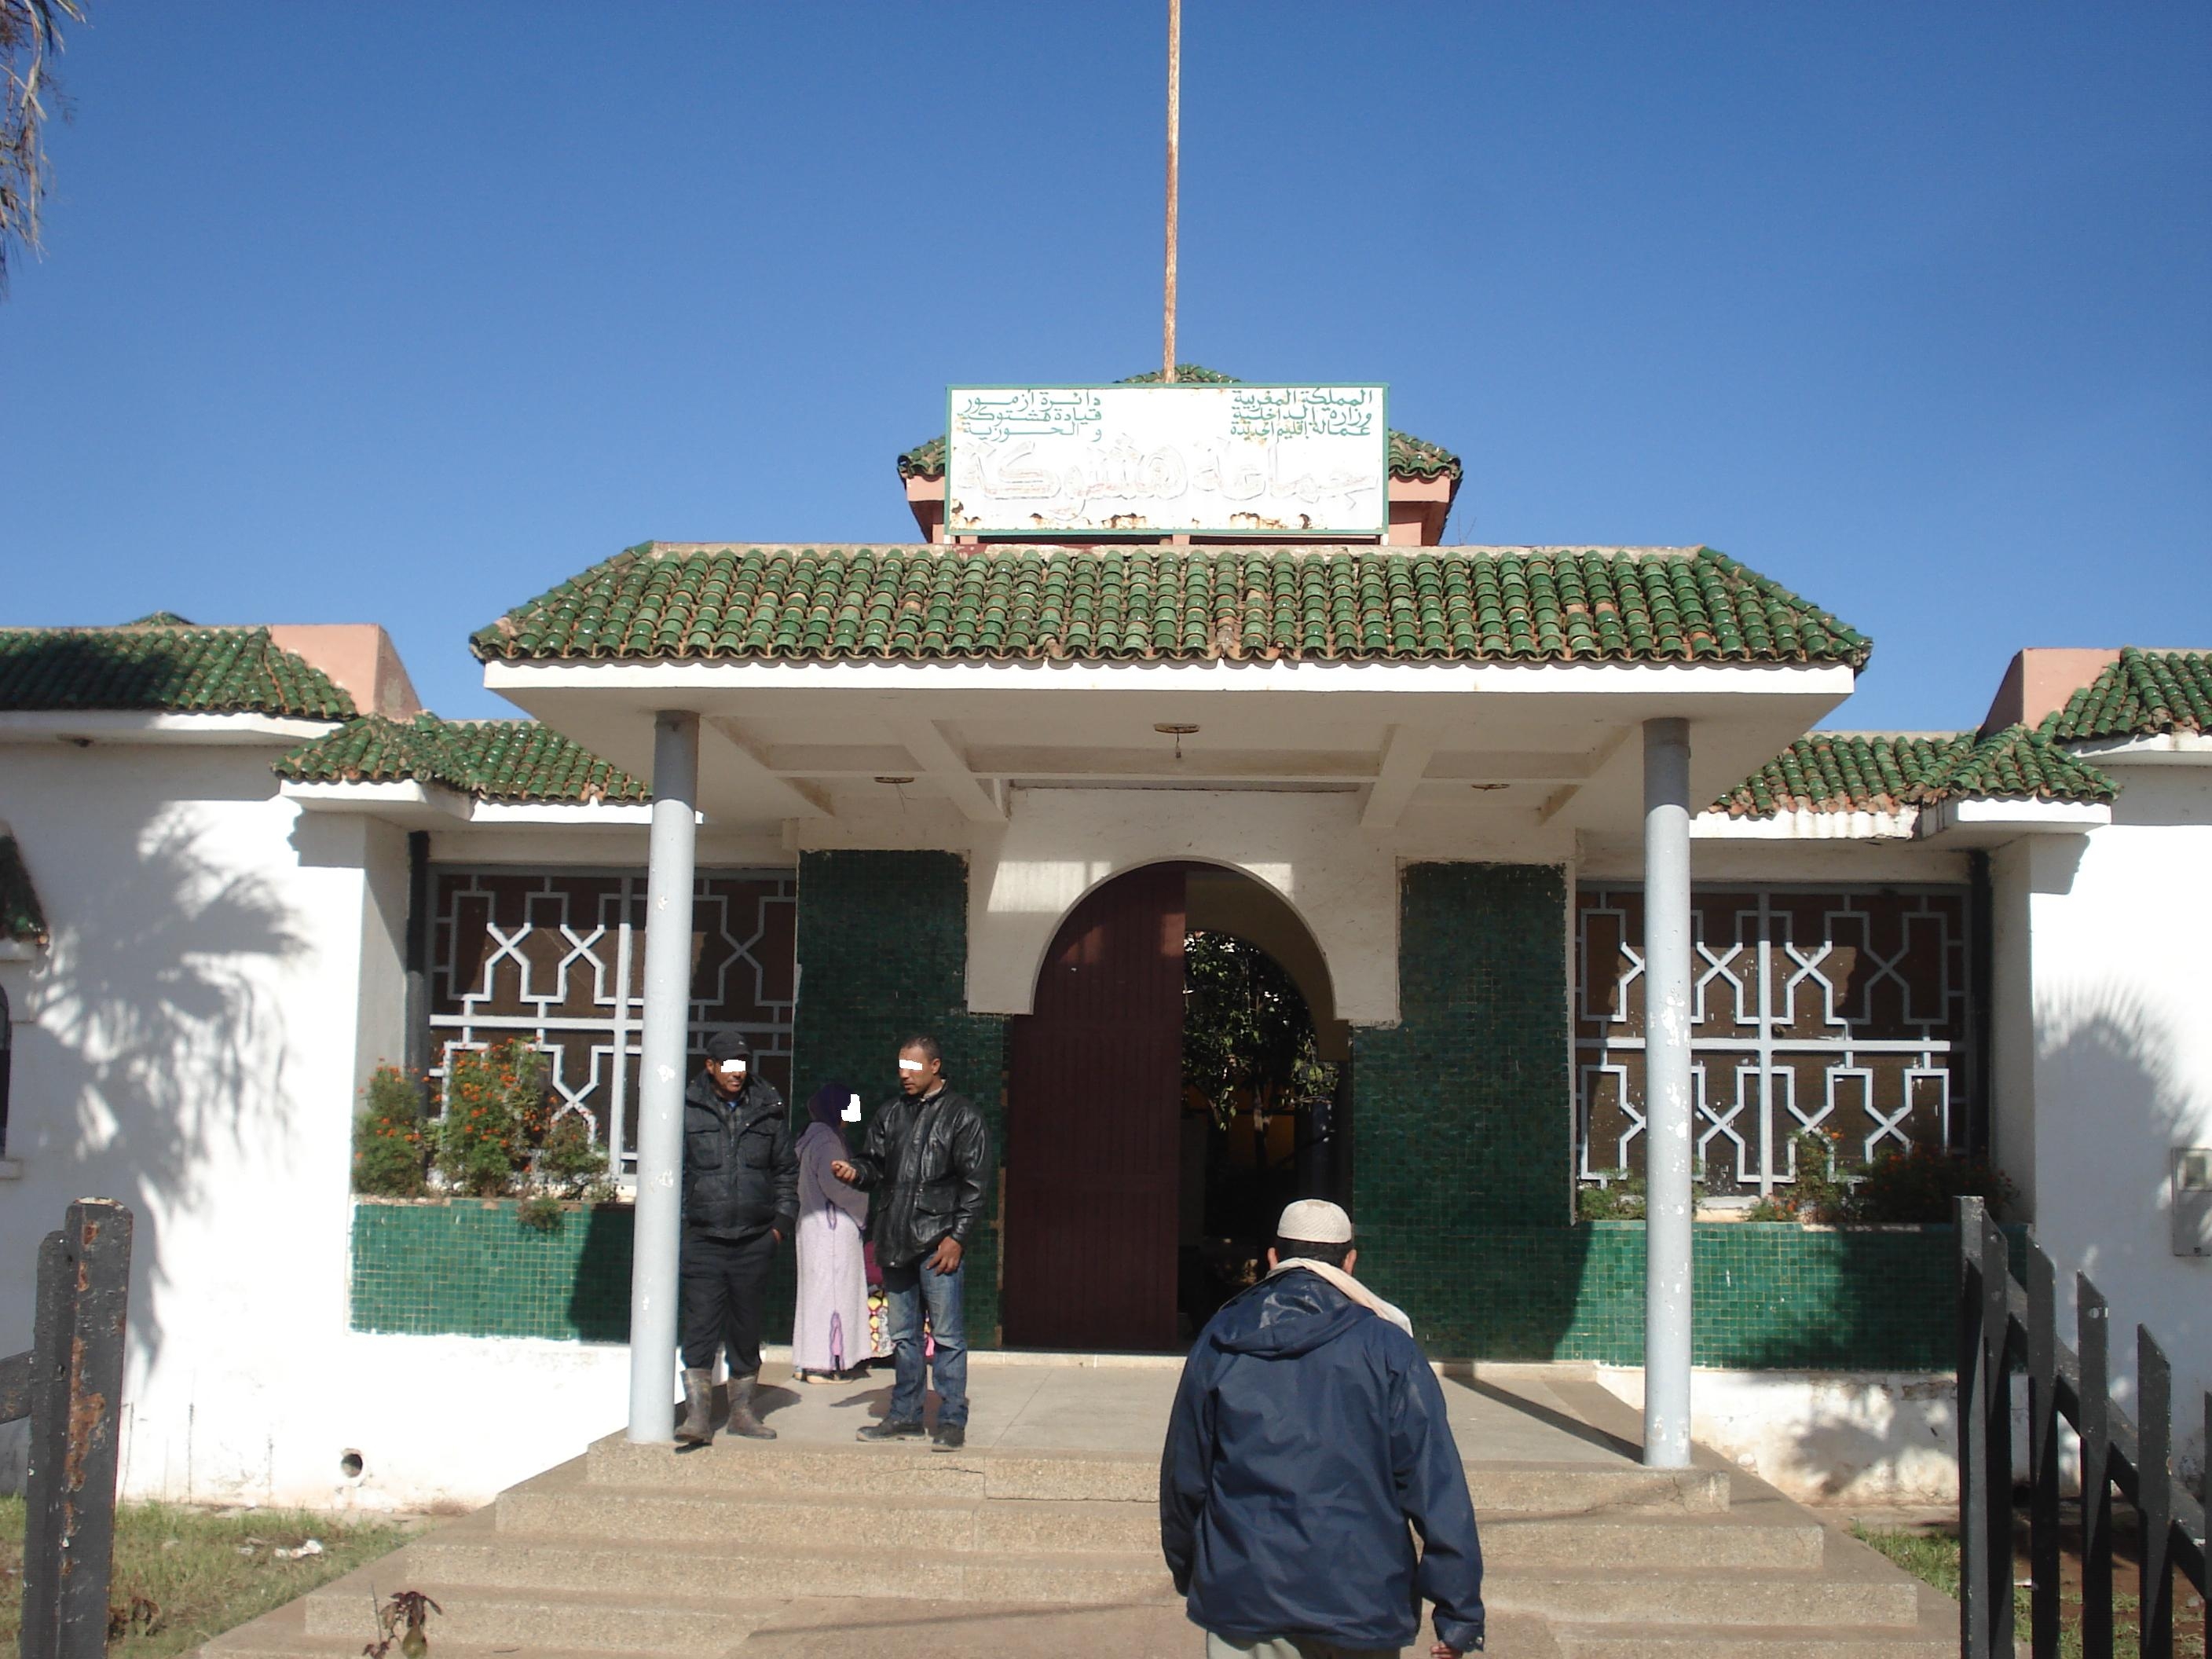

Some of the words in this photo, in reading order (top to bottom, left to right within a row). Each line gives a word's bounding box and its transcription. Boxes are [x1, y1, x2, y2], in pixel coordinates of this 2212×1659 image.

[1232, 388, 1296, 412] المغربية
[1301, 387, 1372, 406] المملكة
[1054, 407, 1102, 425] قيادة
[1232, 405, 1315, 422] الداخلية
[1309, 419, 1371, 437] عمالة
